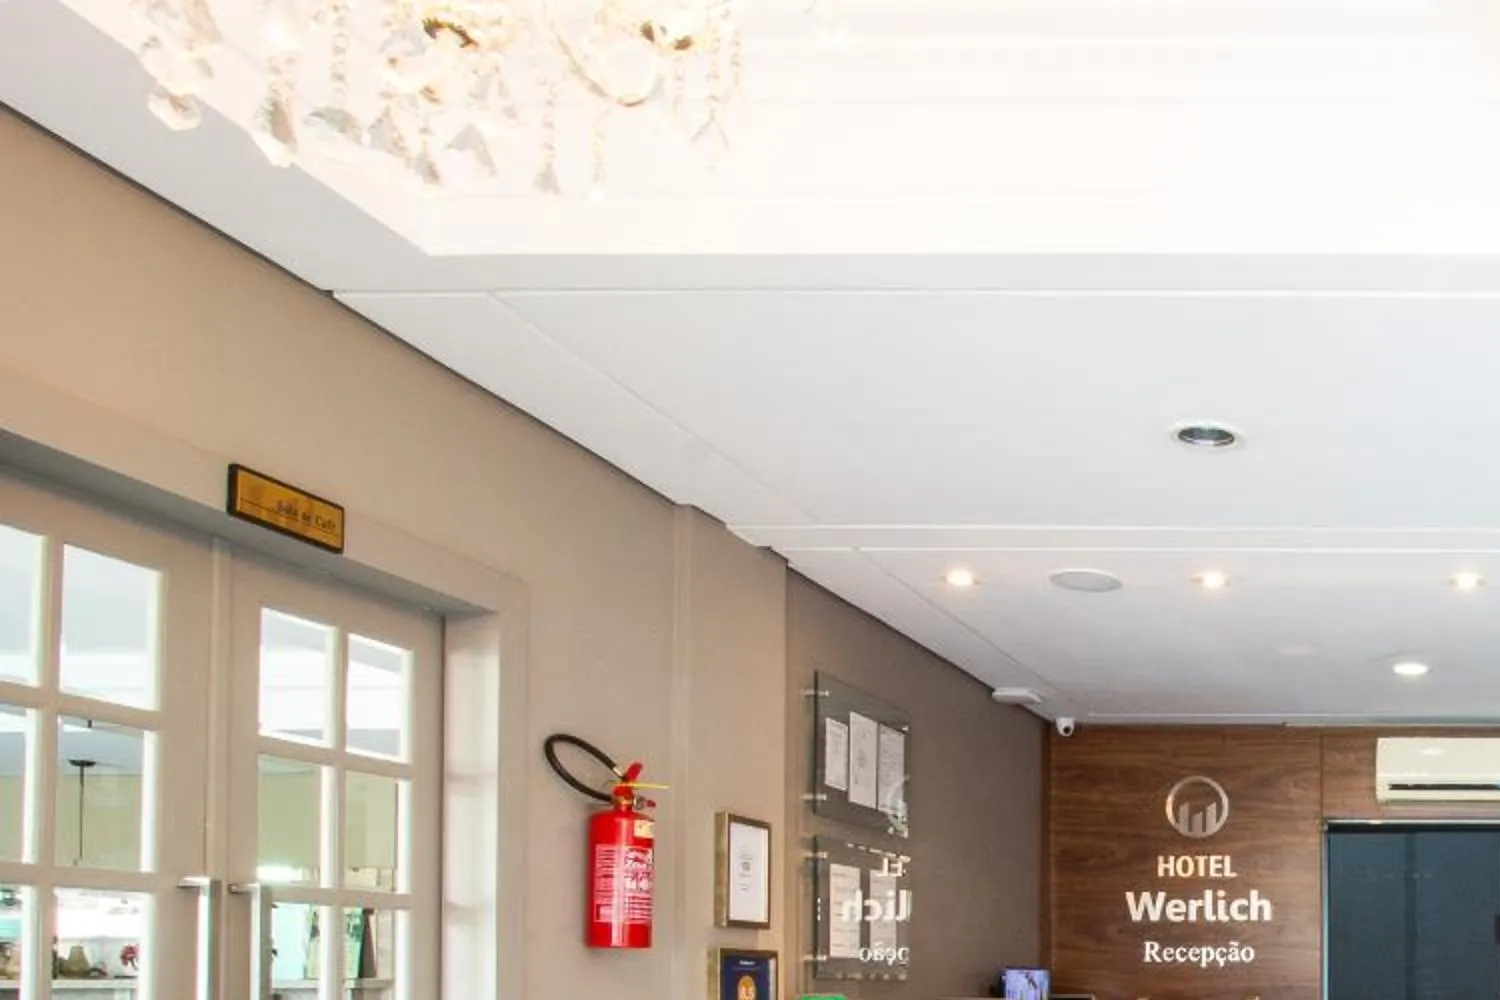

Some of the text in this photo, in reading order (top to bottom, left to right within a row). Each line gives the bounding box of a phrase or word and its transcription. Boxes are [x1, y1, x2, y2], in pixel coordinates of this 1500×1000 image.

[1156, 855, 1239, 878] HOTEL
[1124, 888, 1274, 923] Werlich
[1143, 940, 1257, 969] Recepção
